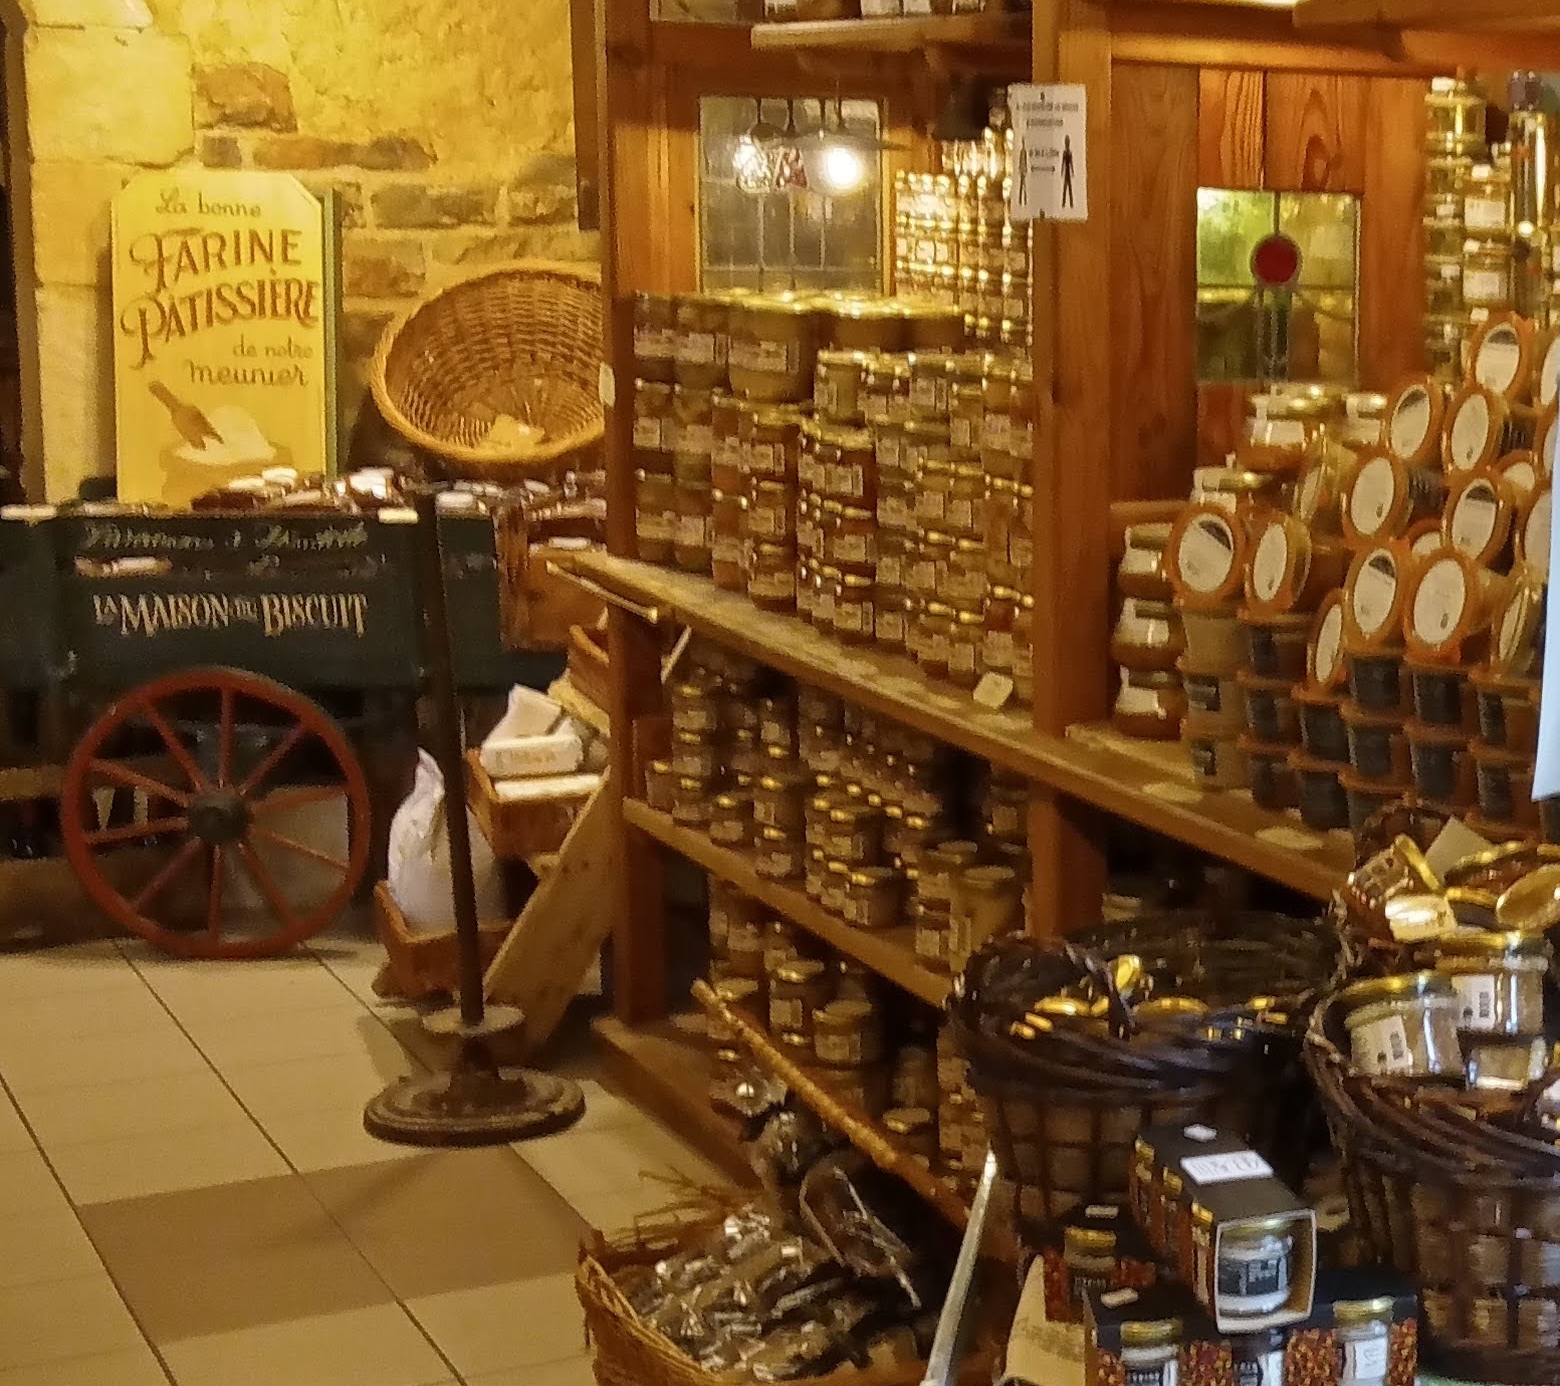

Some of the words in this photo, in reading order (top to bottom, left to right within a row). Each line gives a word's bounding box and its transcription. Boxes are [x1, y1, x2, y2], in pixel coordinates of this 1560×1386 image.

[198, 192, 262, 217] bonne
[129, 227, 302, 296] FARINE
[232, 333, 258, 358] de
[265, 335, 314, 359] notre
[120, 593, 230, 636] MAISON
[260, 593, 368, 638] BISCUIT
